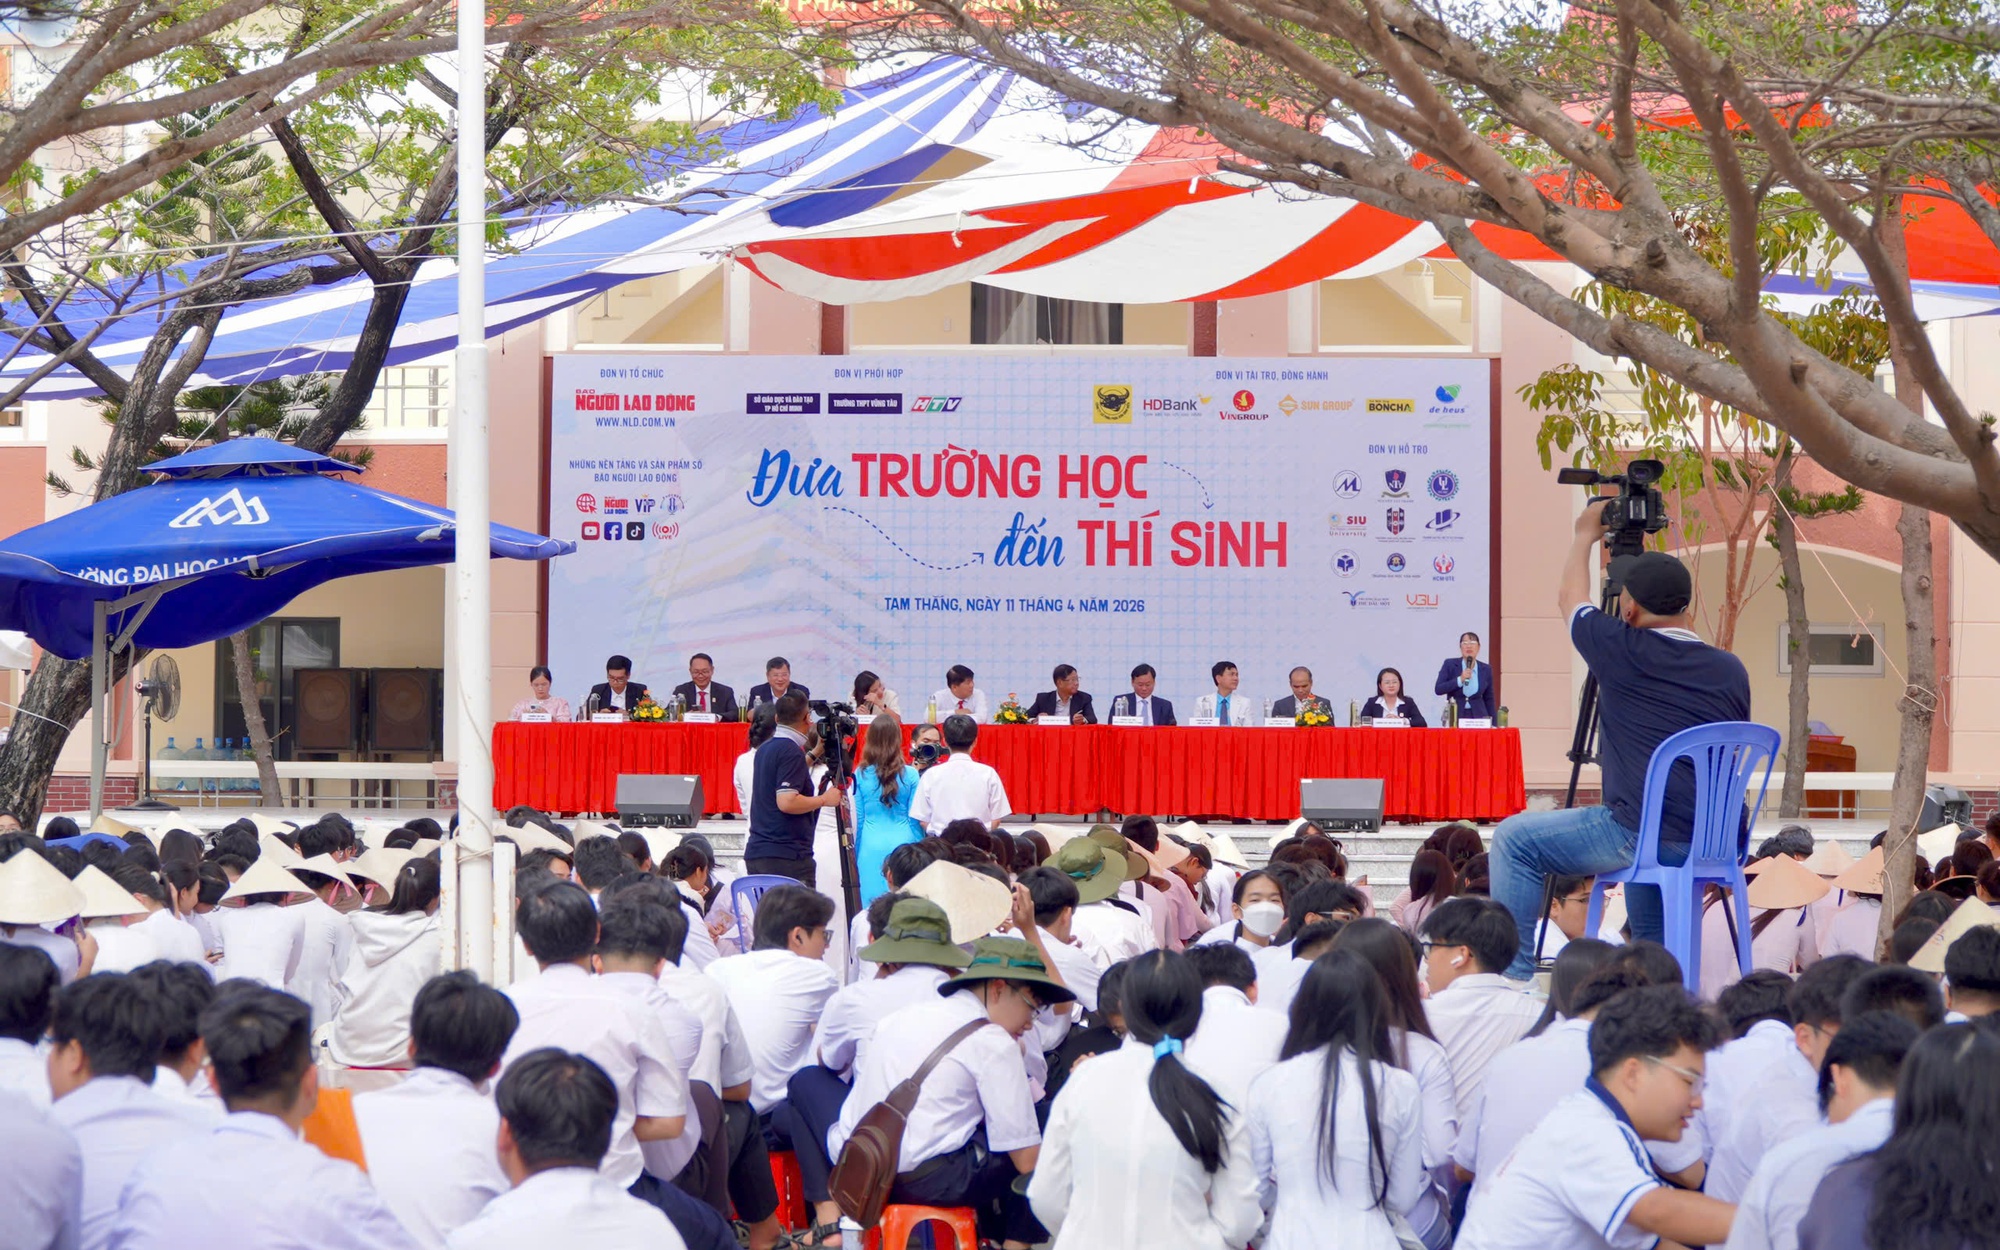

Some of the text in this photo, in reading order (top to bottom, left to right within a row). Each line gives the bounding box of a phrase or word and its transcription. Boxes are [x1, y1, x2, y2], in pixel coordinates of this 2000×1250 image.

[624, 395, 652, 410] LAO
[655, 394, 696, 412] ĐỘNG
[912, 398, 960, 412] HTV
[1143, 399, 1197, 410] HDBank
[1300, 401, 1352, 411] SUN GROUP
[1369, 403, 1412, 412] BONCHA
[1429, 406, 1440, 414] de
[596, 417, 676, 427] WWW.NLD.COM.VN
[747, 443, 1148, 508] Đưa TRƯỜNG HỌC
[1346, 516, 1367, 525] SIU
[994, 512, 1066, 567] đến
[884, 595, 1145, 613] TAM THẮNG, NGÀY 11 THÁNG 4 NĂM 2026
